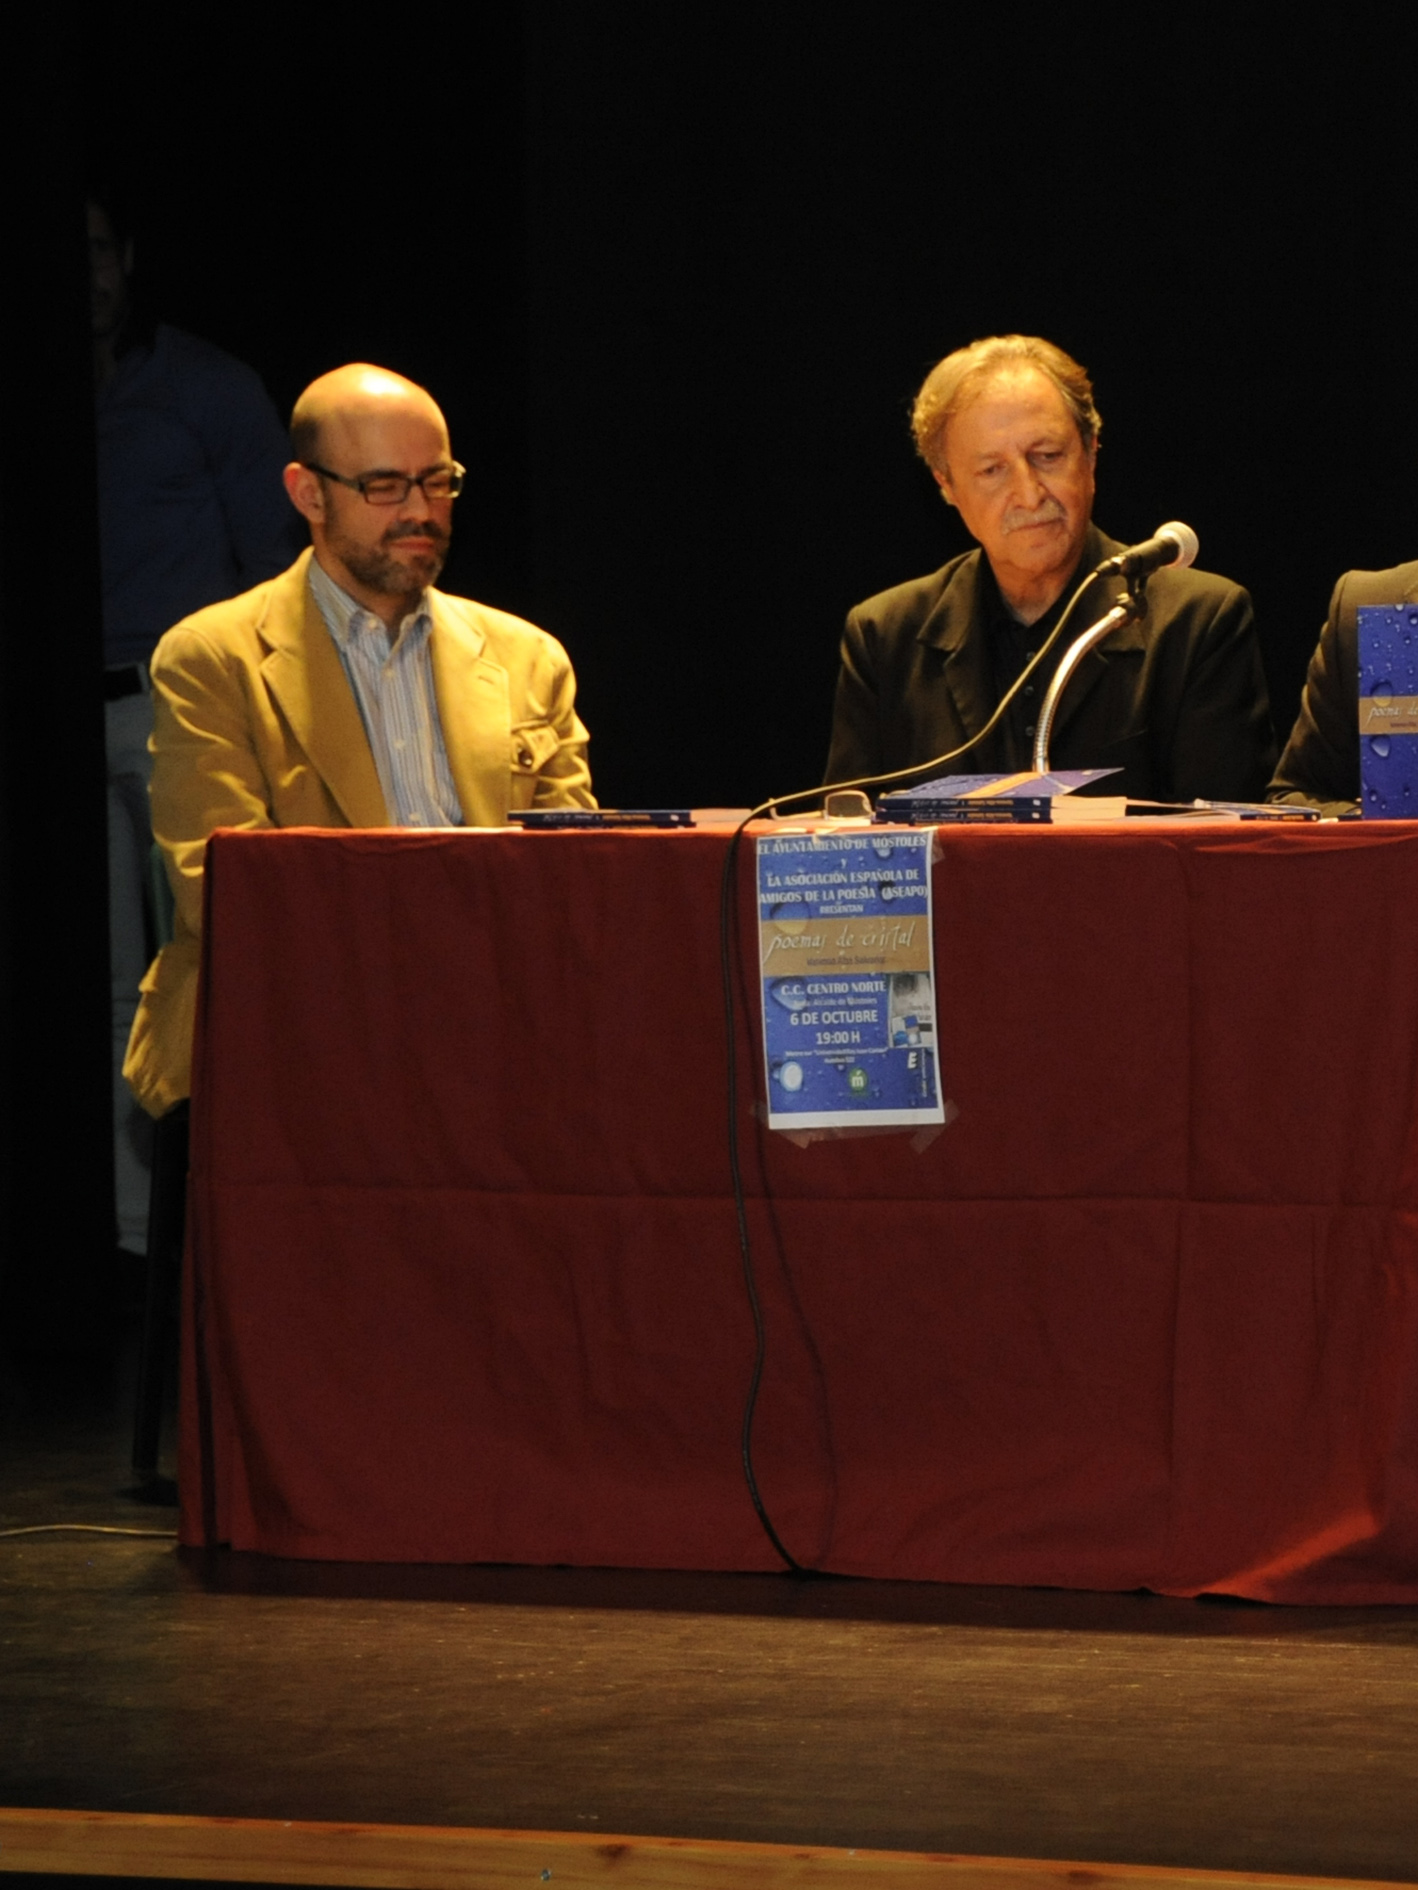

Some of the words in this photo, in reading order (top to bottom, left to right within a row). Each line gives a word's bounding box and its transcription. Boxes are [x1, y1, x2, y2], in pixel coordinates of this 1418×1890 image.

[759, 843, 771, 855] EL
[773, 840, 850, 854] AYUNTAMIENTO
[855, 838, 869, 849] DE
[767, 874, 781, 887] LA
[785, 870, 847, 886] ASOCIACIÓN
[851, 869, 903, 883] ESPAÑOLA
[906, 869, 919, 880] DE
[760, 891, 802, 904] AMIGOS
[805, 890, 819, 901] DE
[823, 889, 835, 901] LA
[837, 885, 876, 900] POESÍA
[881, 885, 929, 900] (ASEAPO)
[764, 931, 827, 964] poemas
[836, 923, 854, 947] de
[862, 921, 916, 950] cristal
[781, 984, 805, 996] C.C.
[807, 981, 849, 995] CENTRO
[852, 980, 887, 993] NORTE
[790, 1014, 799, 1026] 6
[802, 1012, 819, 1025] DE
[823, 1009, 878, 1024] OCTUBRE
[815, 1032, 849, 1045] 19:00
[852, 1031, 861, 1043] H
